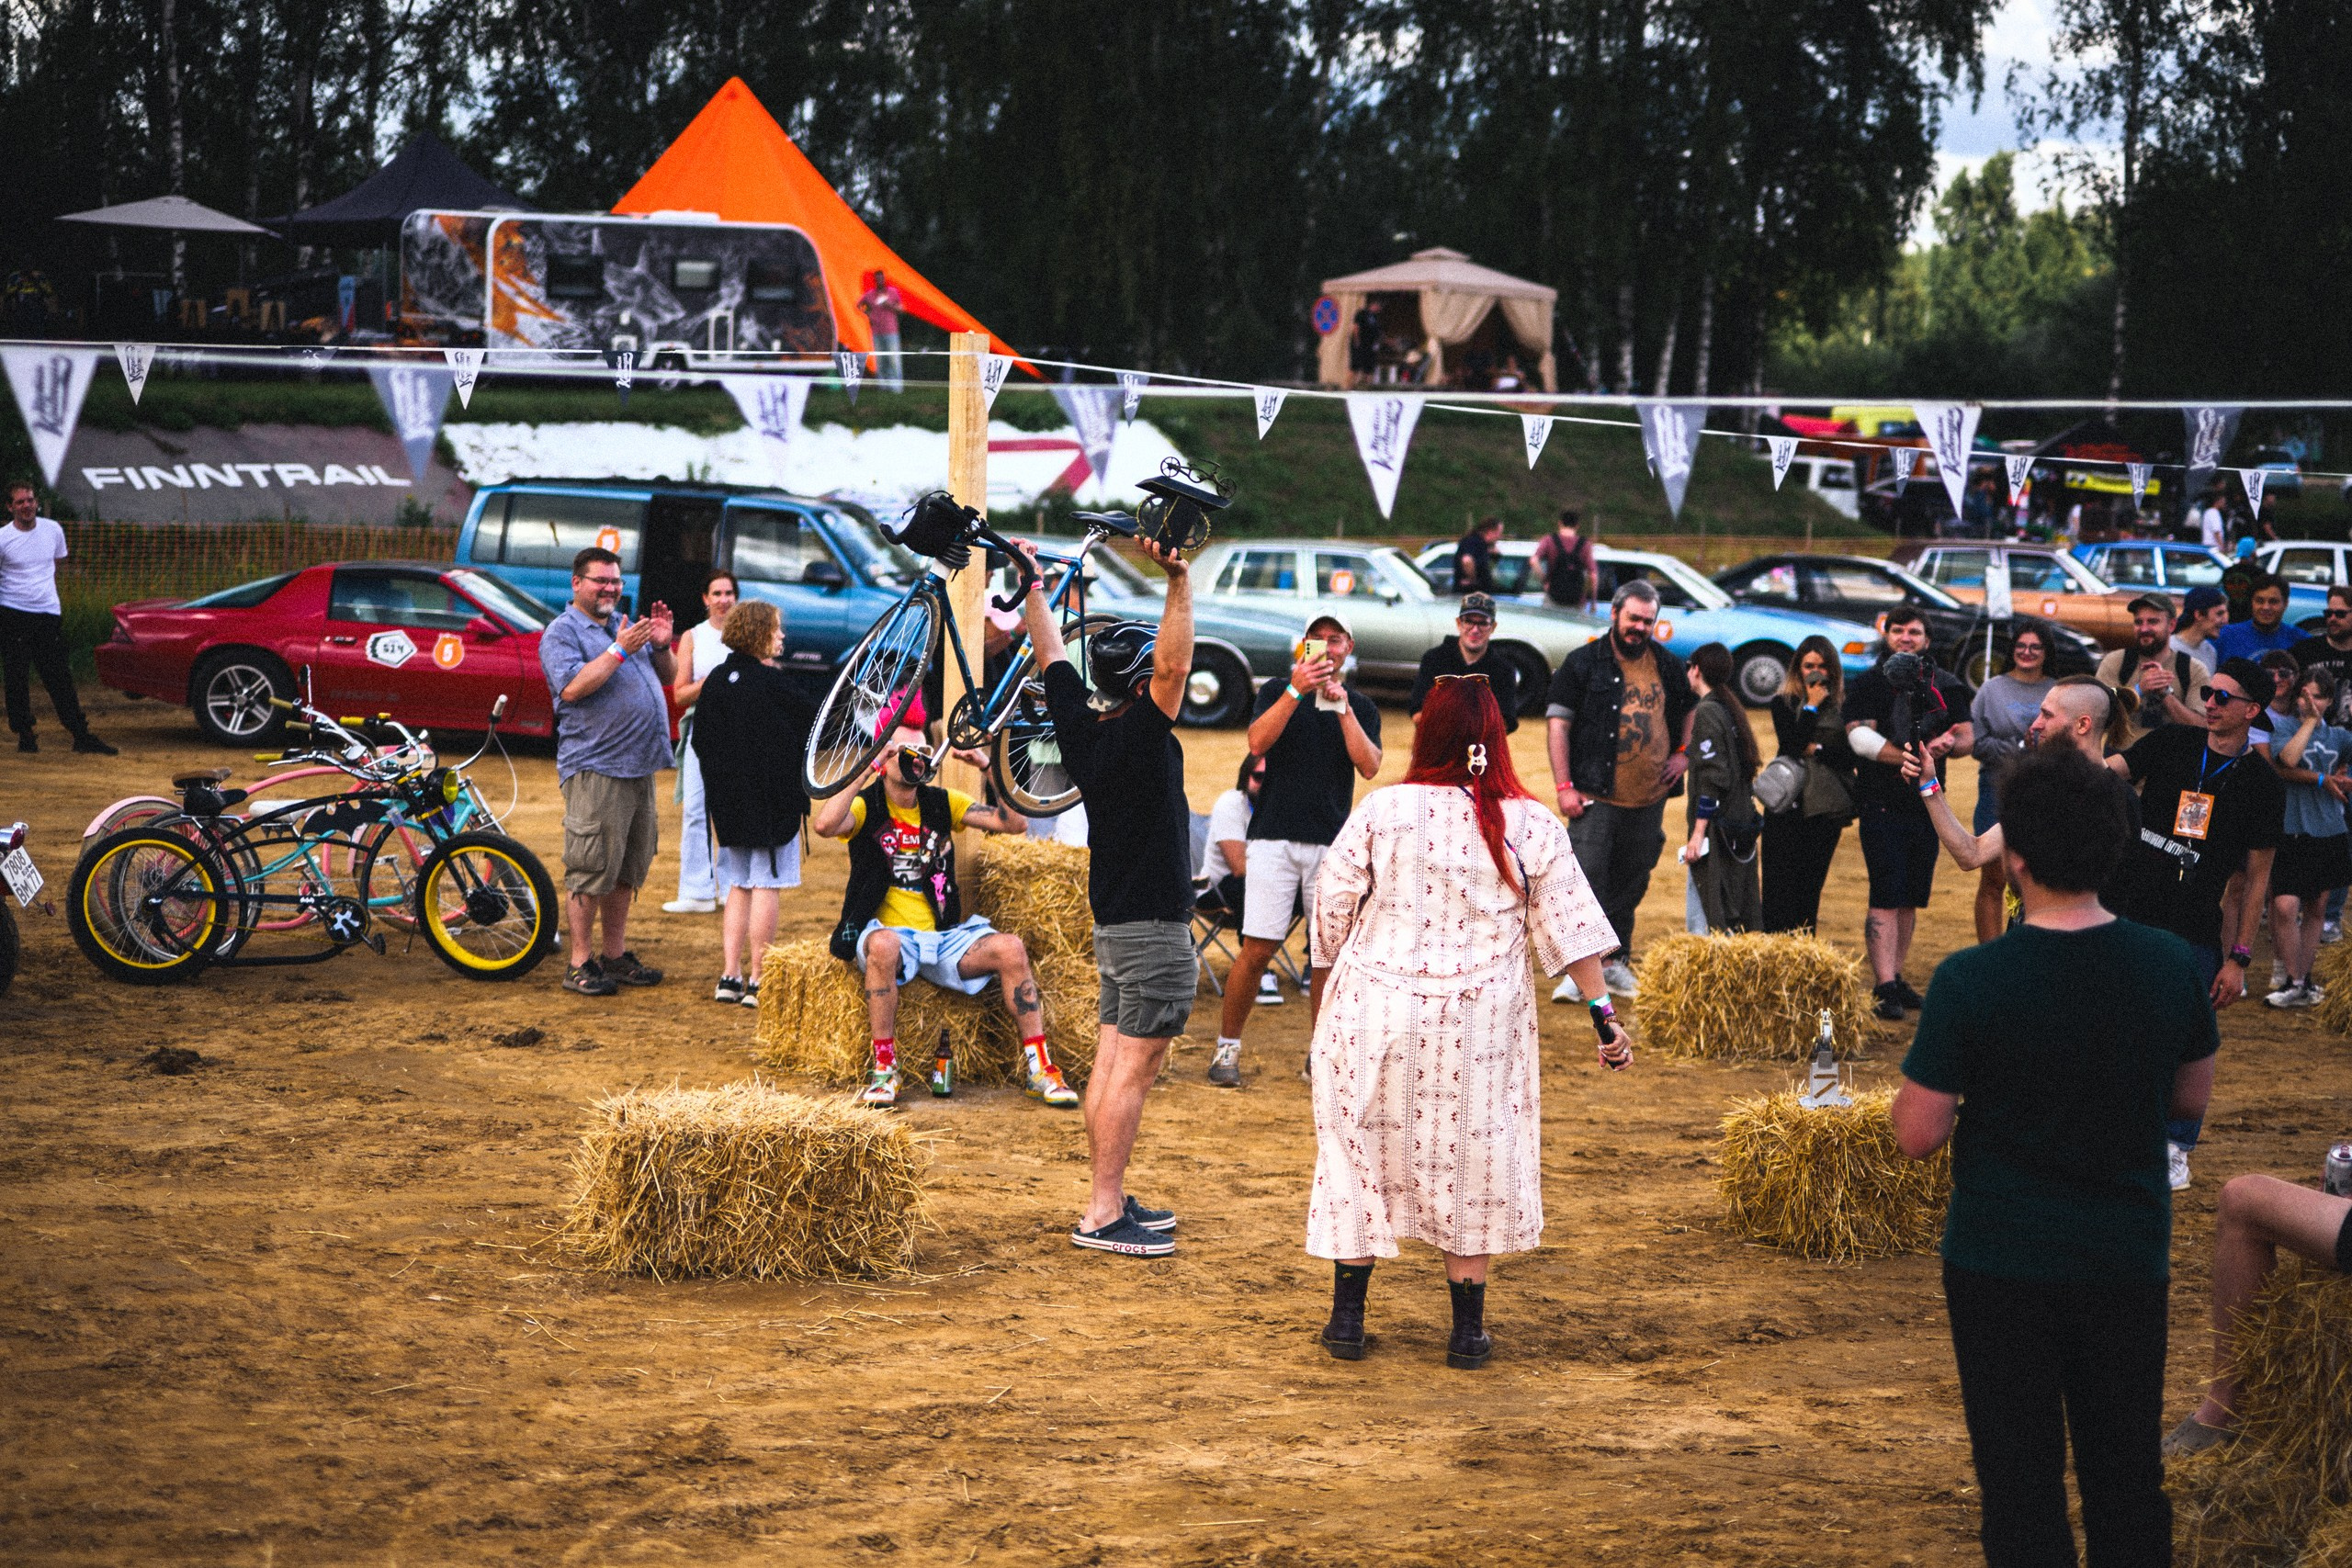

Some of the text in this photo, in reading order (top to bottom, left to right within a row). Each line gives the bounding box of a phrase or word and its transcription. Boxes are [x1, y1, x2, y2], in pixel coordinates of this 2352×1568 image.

[82, 462, 413, 491] FINNTRAIL
[4, 850, 27, 881] 7808
[1112, 1243, 1147, 1254] crocs
